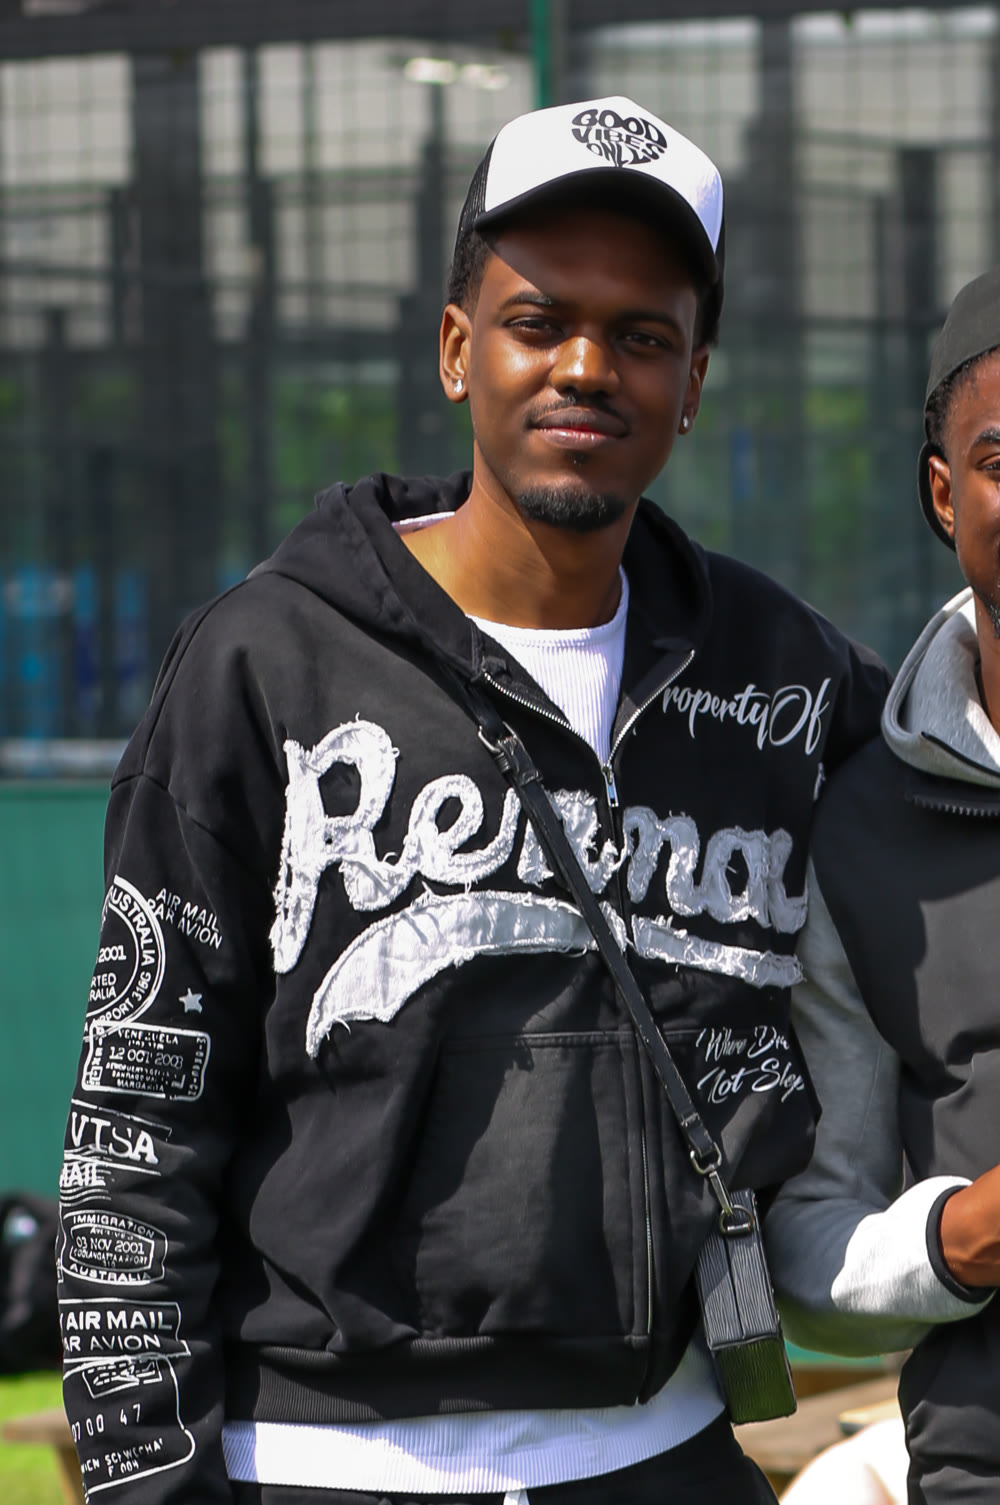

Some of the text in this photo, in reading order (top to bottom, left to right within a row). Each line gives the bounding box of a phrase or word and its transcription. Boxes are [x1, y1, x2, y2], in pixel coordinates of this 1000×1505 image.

[571, 109, 668, 148] GOOD
[571, 126, 665, 160] VIBES
[156, 888, 221, 933] AIR MAIL
[146, 898, 223, 950] PAR AVION
[109, 1046, 126, 1060] 12
[73, 1214, 154, 1238] IMMIGRATION
[90, 1237, 112, 1251] NOV
[115, 1240, 144, 1255] 2001
[70, 1263, 151, 1281] AUSTRALIA
[66, 1310, 172, 1330] AIR MAIL
[90, 1334, 160, 1351] AVION
